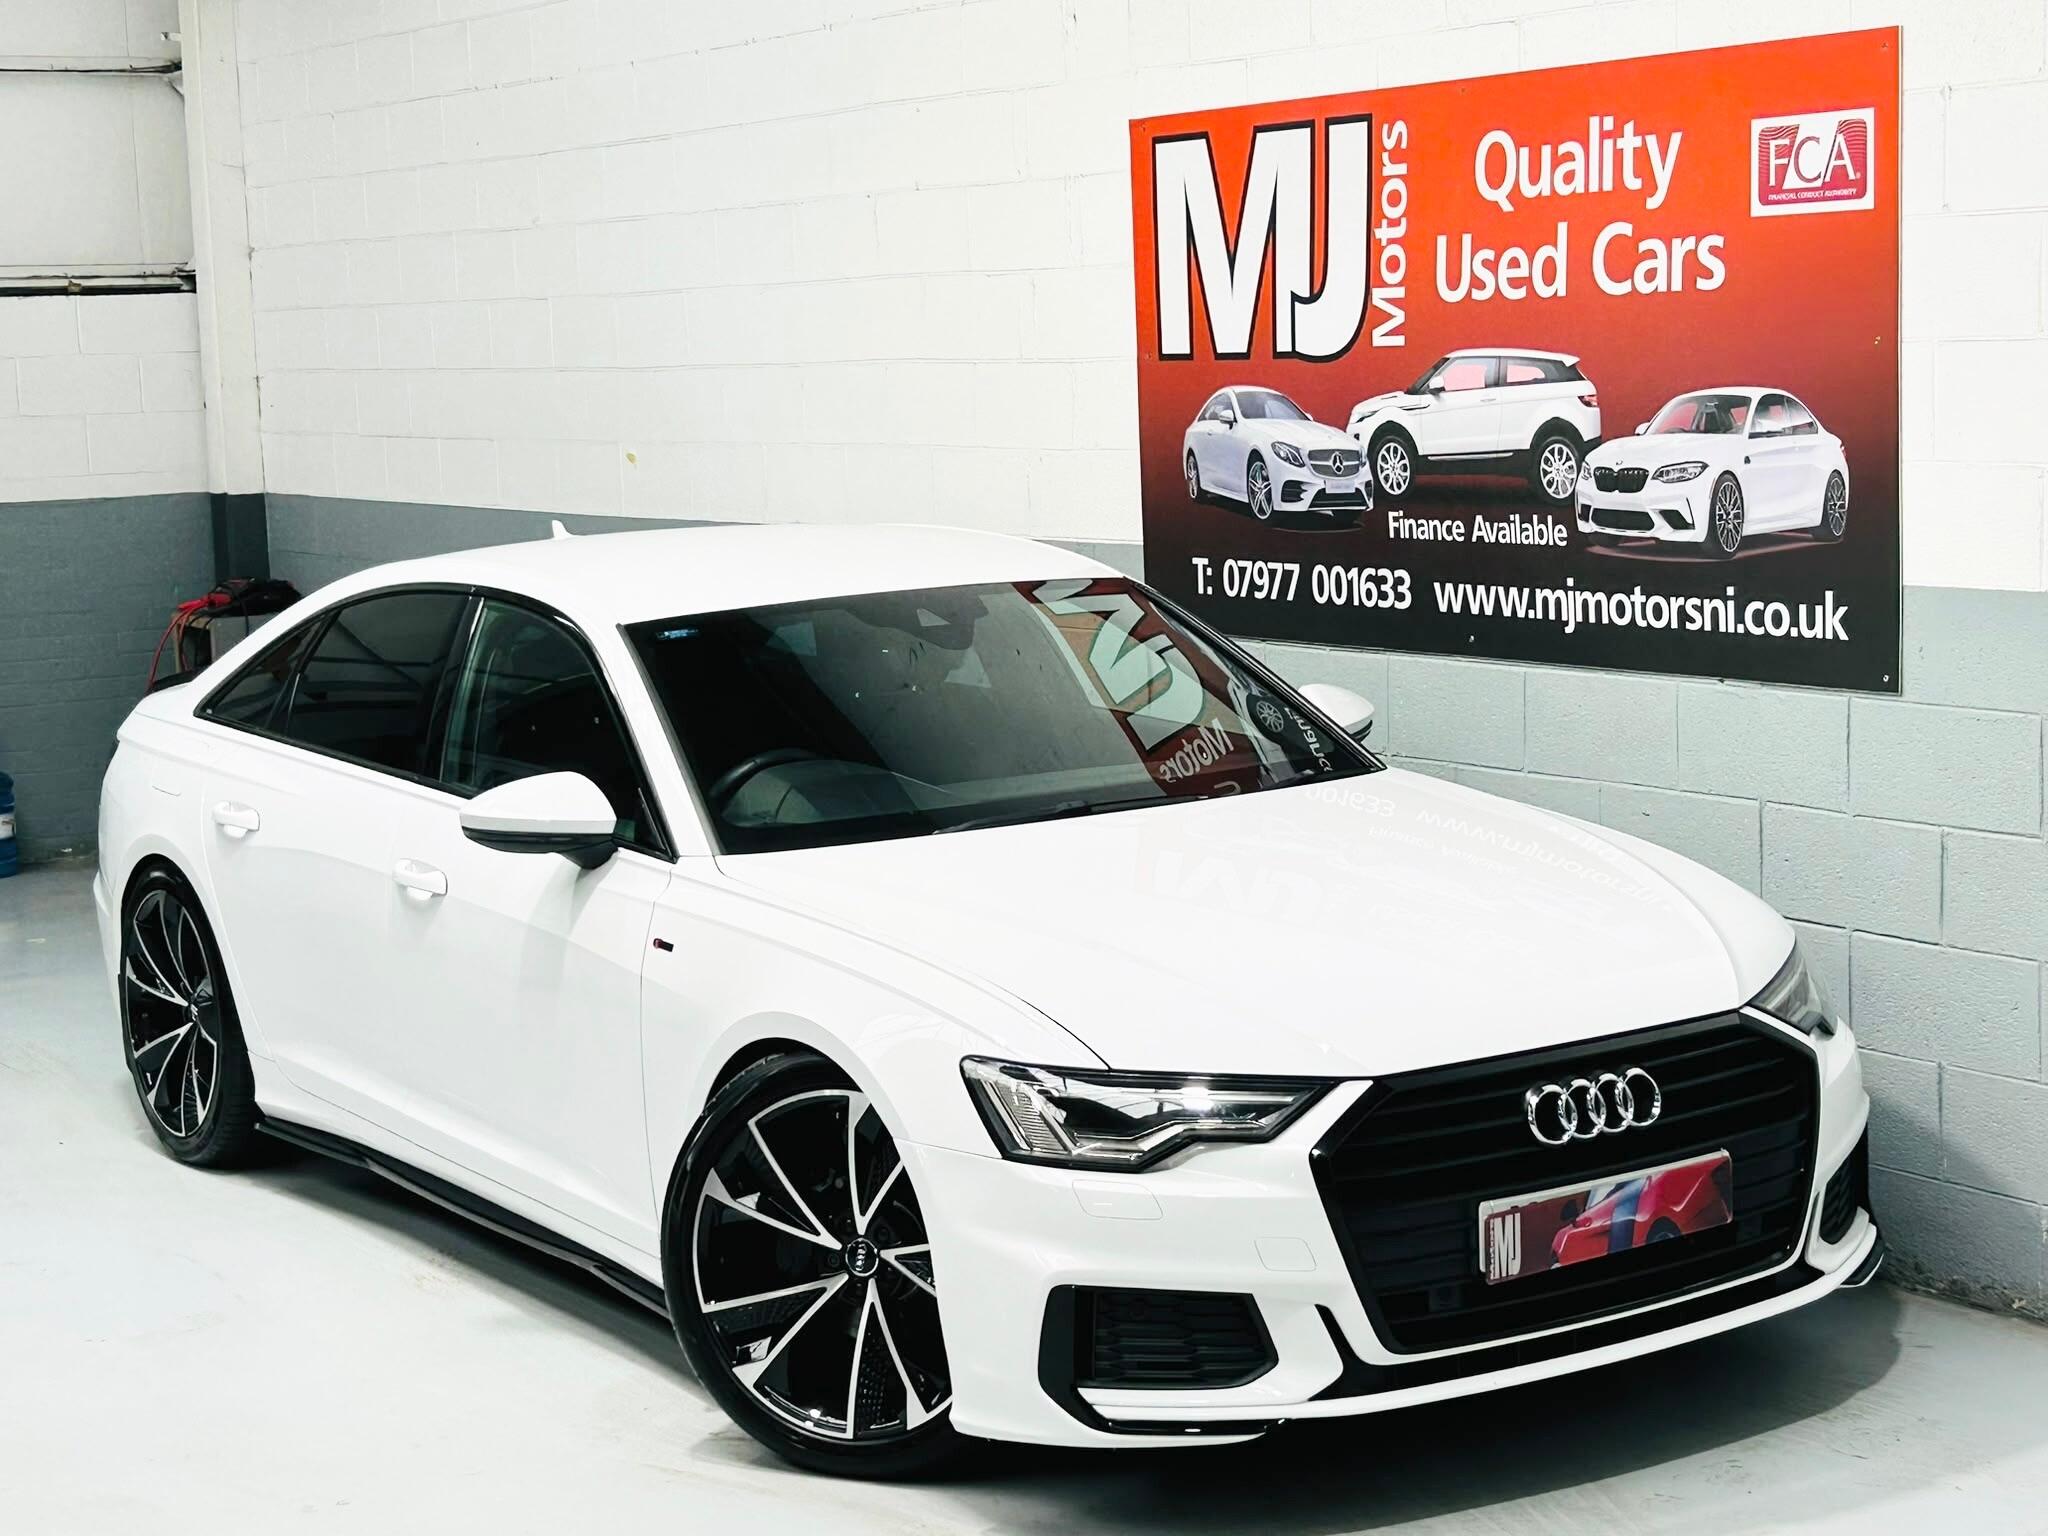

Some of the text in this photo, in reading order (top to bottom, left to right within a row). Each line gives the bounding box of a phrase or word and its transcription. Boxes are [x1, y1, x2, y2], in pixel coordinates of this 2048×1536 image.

[1474, 115, 1683, 210] Quality
[1768, 133, 1856, 187] FCA
[1152, 114, 1373, 362] MJ
[1372, 119, 1408, 347] Motors
[1436, 221, 1726, 303] Used Cars
[1387, 510, 1568, 547] Finance Available
[1191, 557, 1849, 641] T: 07977 001633 www.mjmotorsni.co.uk
[1493, 1213, 1521, 1280] MJ
